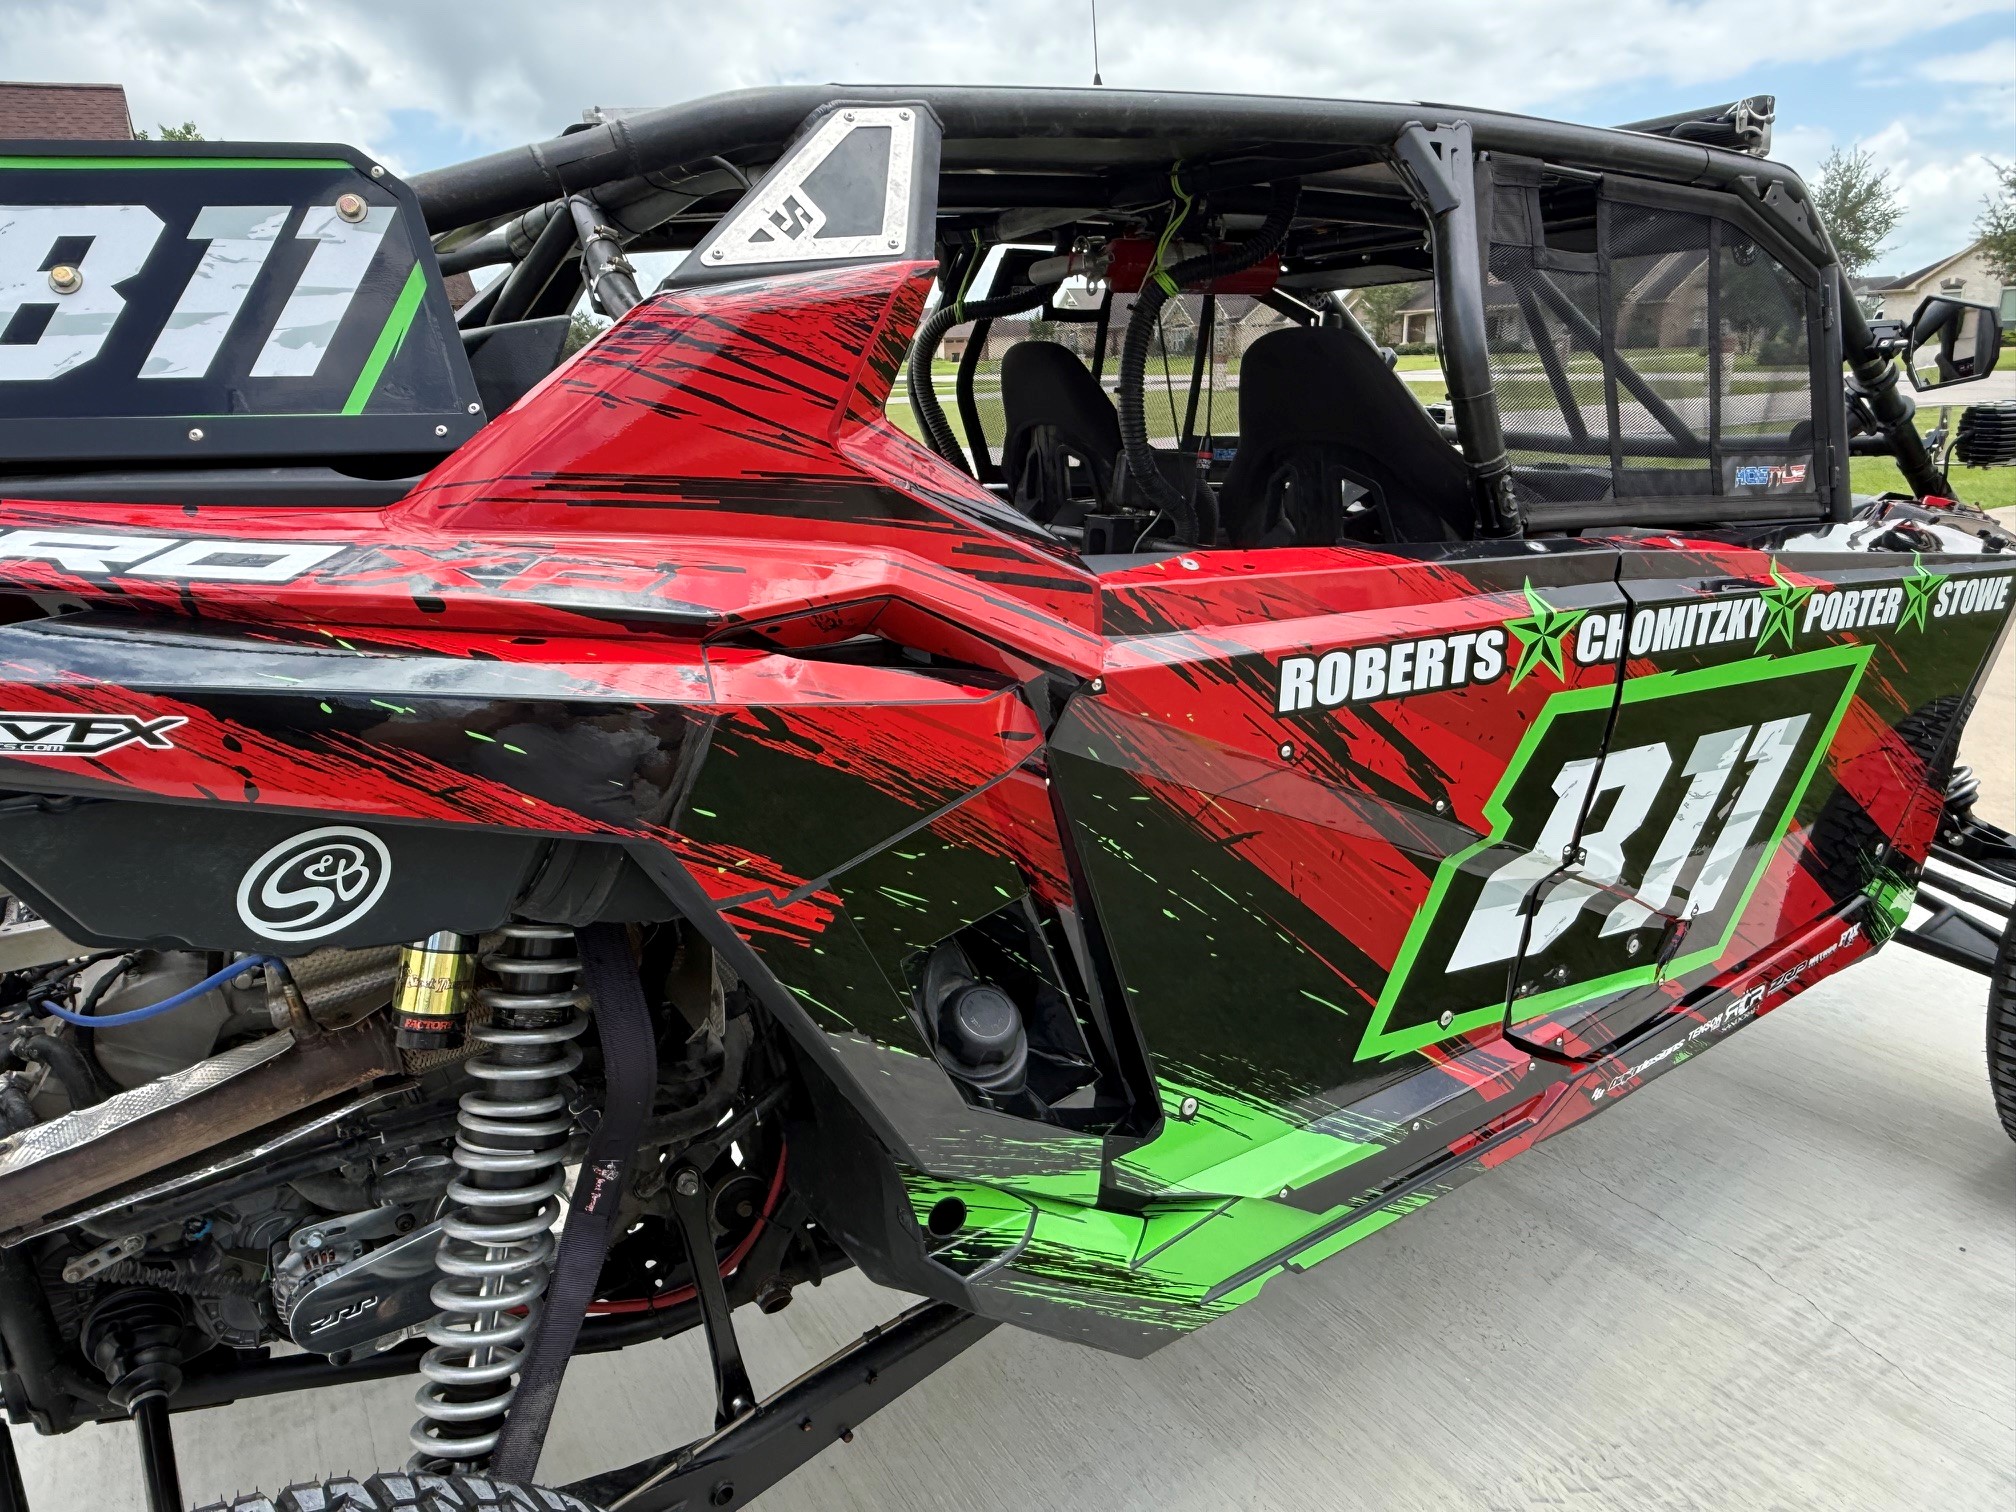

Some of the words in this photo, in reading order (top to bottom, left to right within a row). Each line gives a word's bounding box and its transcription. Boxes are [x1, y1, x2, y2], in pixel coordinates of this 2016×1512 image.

[1278, 629, 1506, 713] ROBERTS
[1575, 597, 1768, 664] CHOMITZKY
[1802, 588, 1903, 633] PORTER
[1933, 576, 2013, 618] STOWE
[404, 1019, 455, 1031] FACTORY
